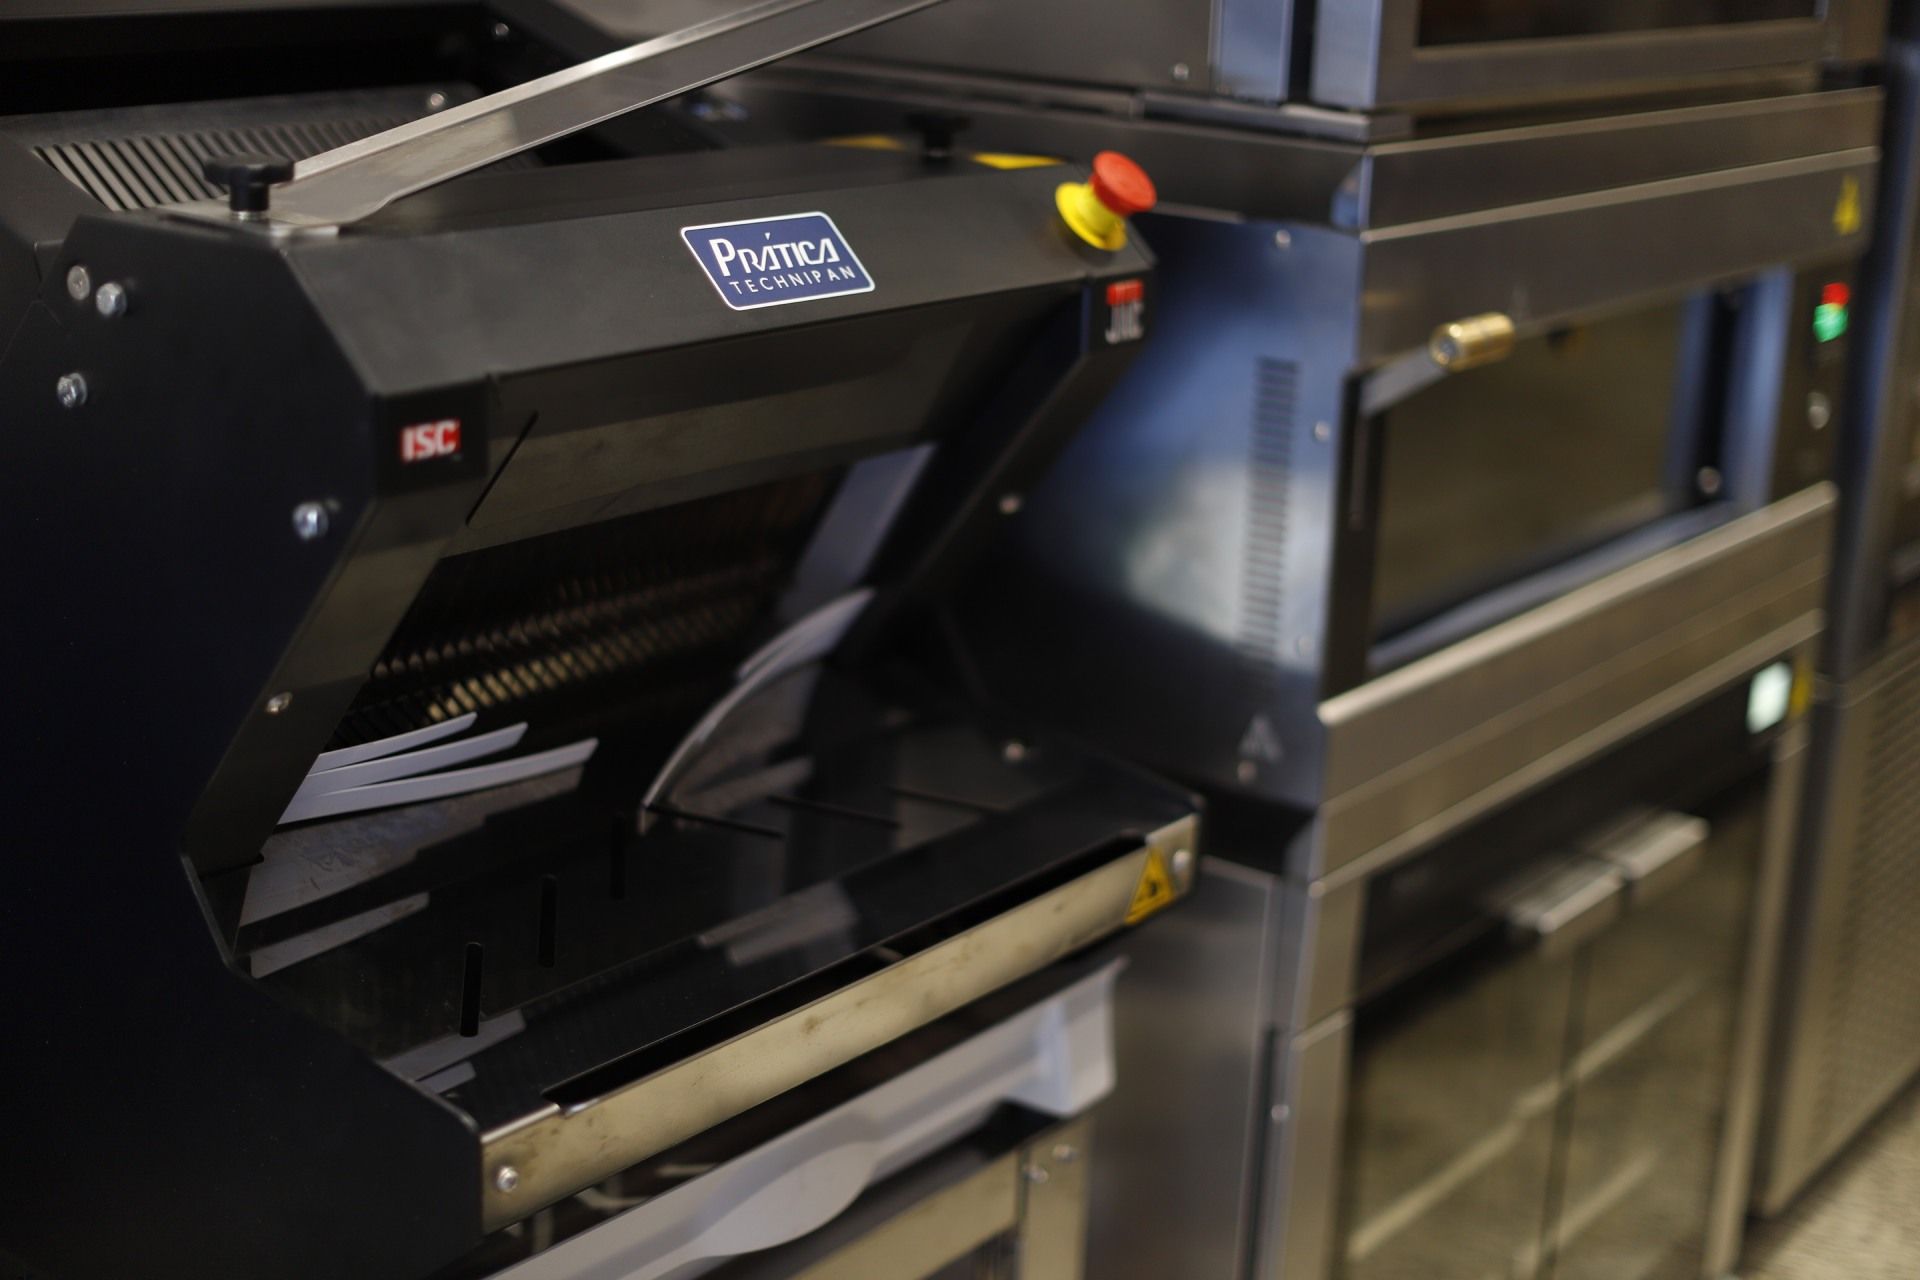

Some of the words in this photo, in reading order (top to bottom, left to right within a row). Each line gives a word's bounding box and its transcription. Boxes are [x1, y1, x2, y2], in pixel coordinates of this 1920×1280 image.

[708, 232, 840, 276] PRÁTICA
[729, 266, 856, 295] TECHNIPAN
[402, 420, 460, 461] ISC
